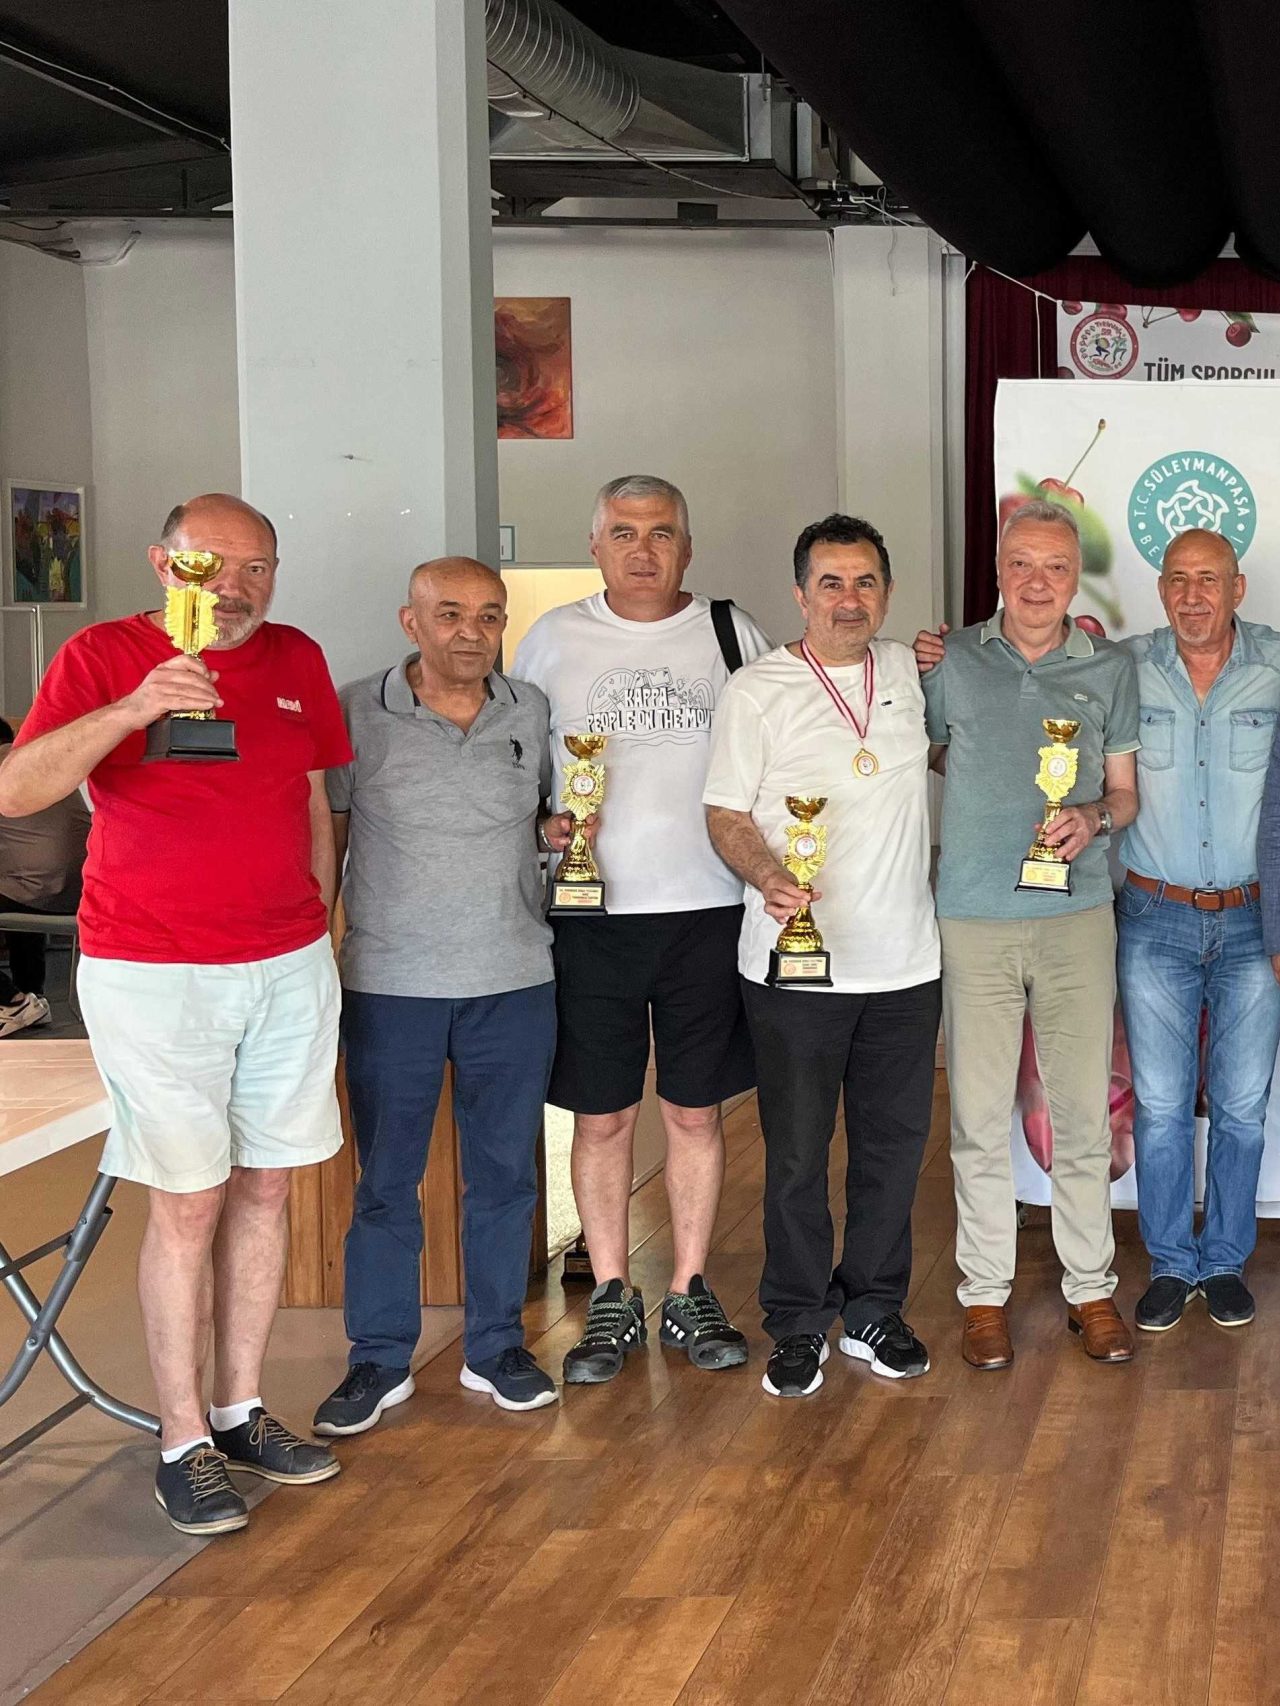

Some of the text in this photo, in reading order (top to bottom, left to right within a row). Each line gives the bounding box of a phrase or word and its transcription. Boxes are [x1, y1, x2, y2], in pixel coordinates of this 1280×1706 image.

[1143, 357, 1185, 381] TÜM
[1144, 457, 1250, 517] SÜLEYMANPAŞA
[624, 687, 669, 708] KAPPA
[587, 707, 711, 732] PEOPLE ON THE MOV
